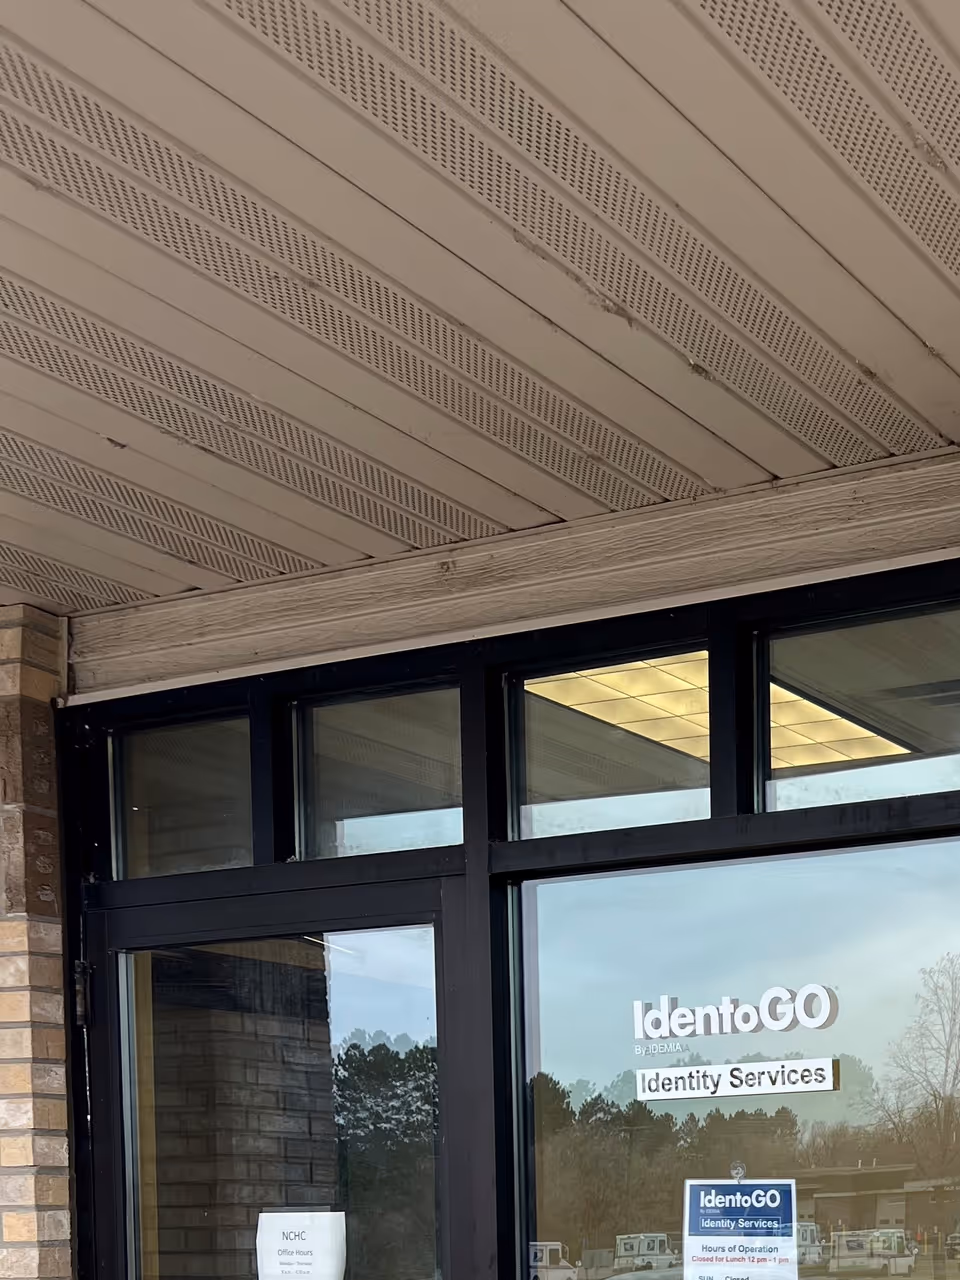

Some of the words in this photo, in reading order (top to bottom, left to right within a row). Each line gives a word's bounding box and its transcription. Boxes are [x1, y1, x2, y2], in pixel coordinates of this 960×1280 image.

[633, 983, 831, 1040] IdentoGO
[649, 1042, 682, 1054] IDEMIA
[641, 1069, 722, 1095] Identity
[729, 1065, 827, 1089] Services
[700, 1189, 781, 1208] IdentoGO
[701, 1219, 736, 1230] Identity
[738, 1218, 779, 1228] Services
[282, 1231, 306, 1241] NCHC
[277, 1248, 294, 1256] Office
[701, 1244, 726, 1253] Hours
[727, 1244, 737, 1253] of
[738, 1245, 779, 1255] Operation
